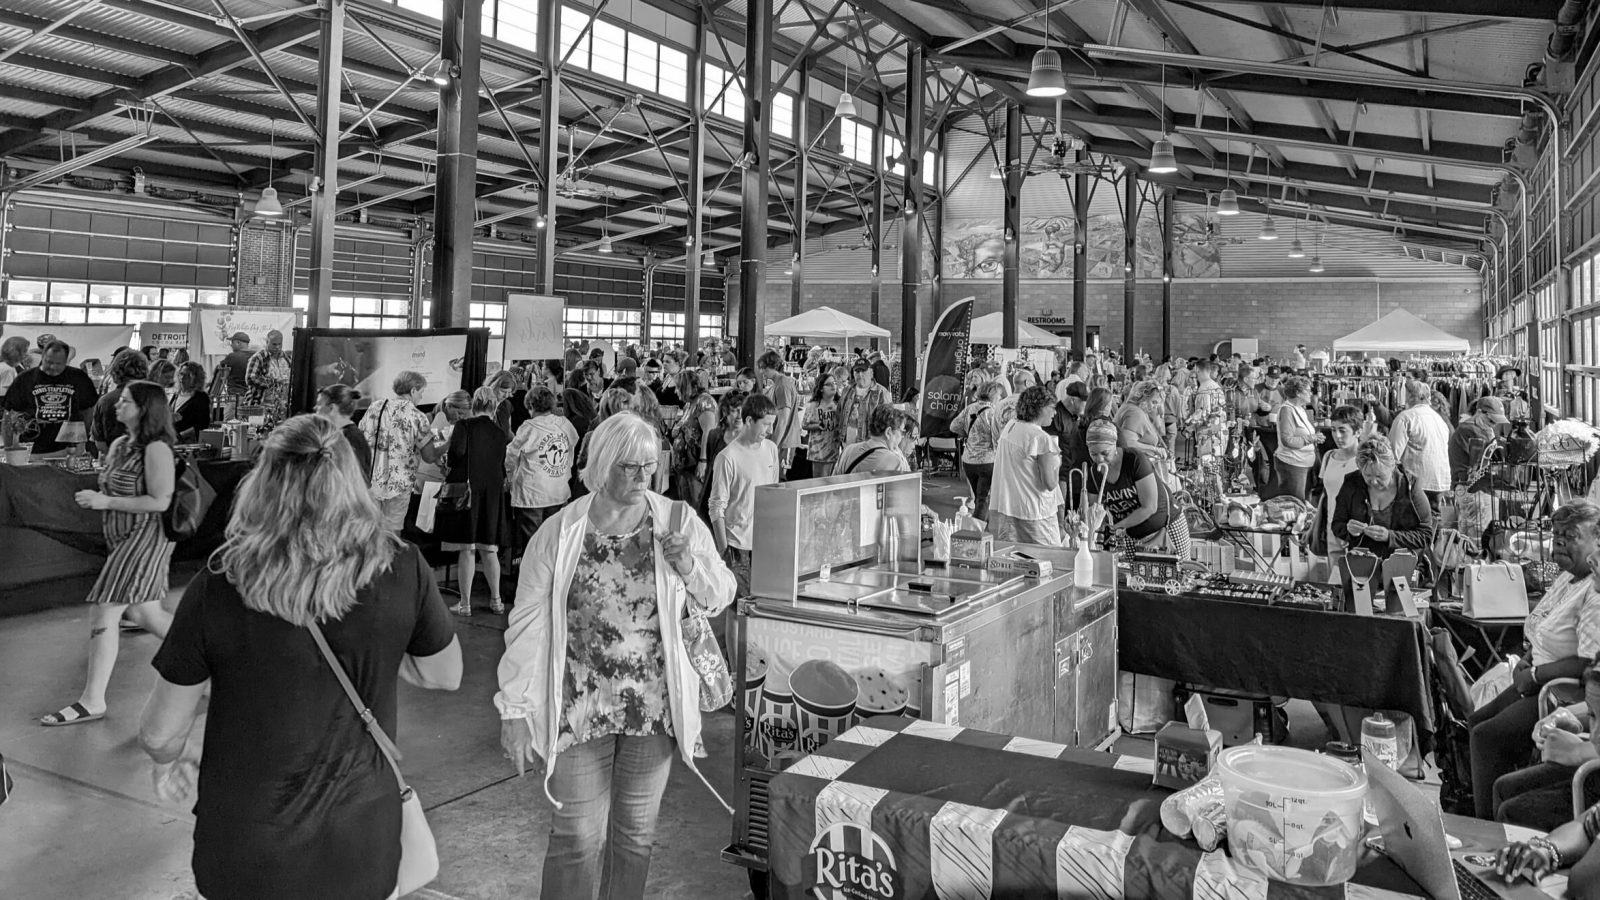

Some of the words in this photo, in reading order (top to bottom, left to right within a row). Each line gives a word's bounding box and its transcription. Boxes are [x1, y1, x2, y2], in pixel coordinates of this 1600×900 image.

[1027, 316, 1066, 324] RESTROOMS
[151, 333, 187, 341] DETROIT
[954, 338, 965, 375] original
[927, 389, 962, 402] salami
[930, 400, 959, 413] chips
[763, 721, 796, 740] Rita's
[815, 847, 895, 898] Rita's
